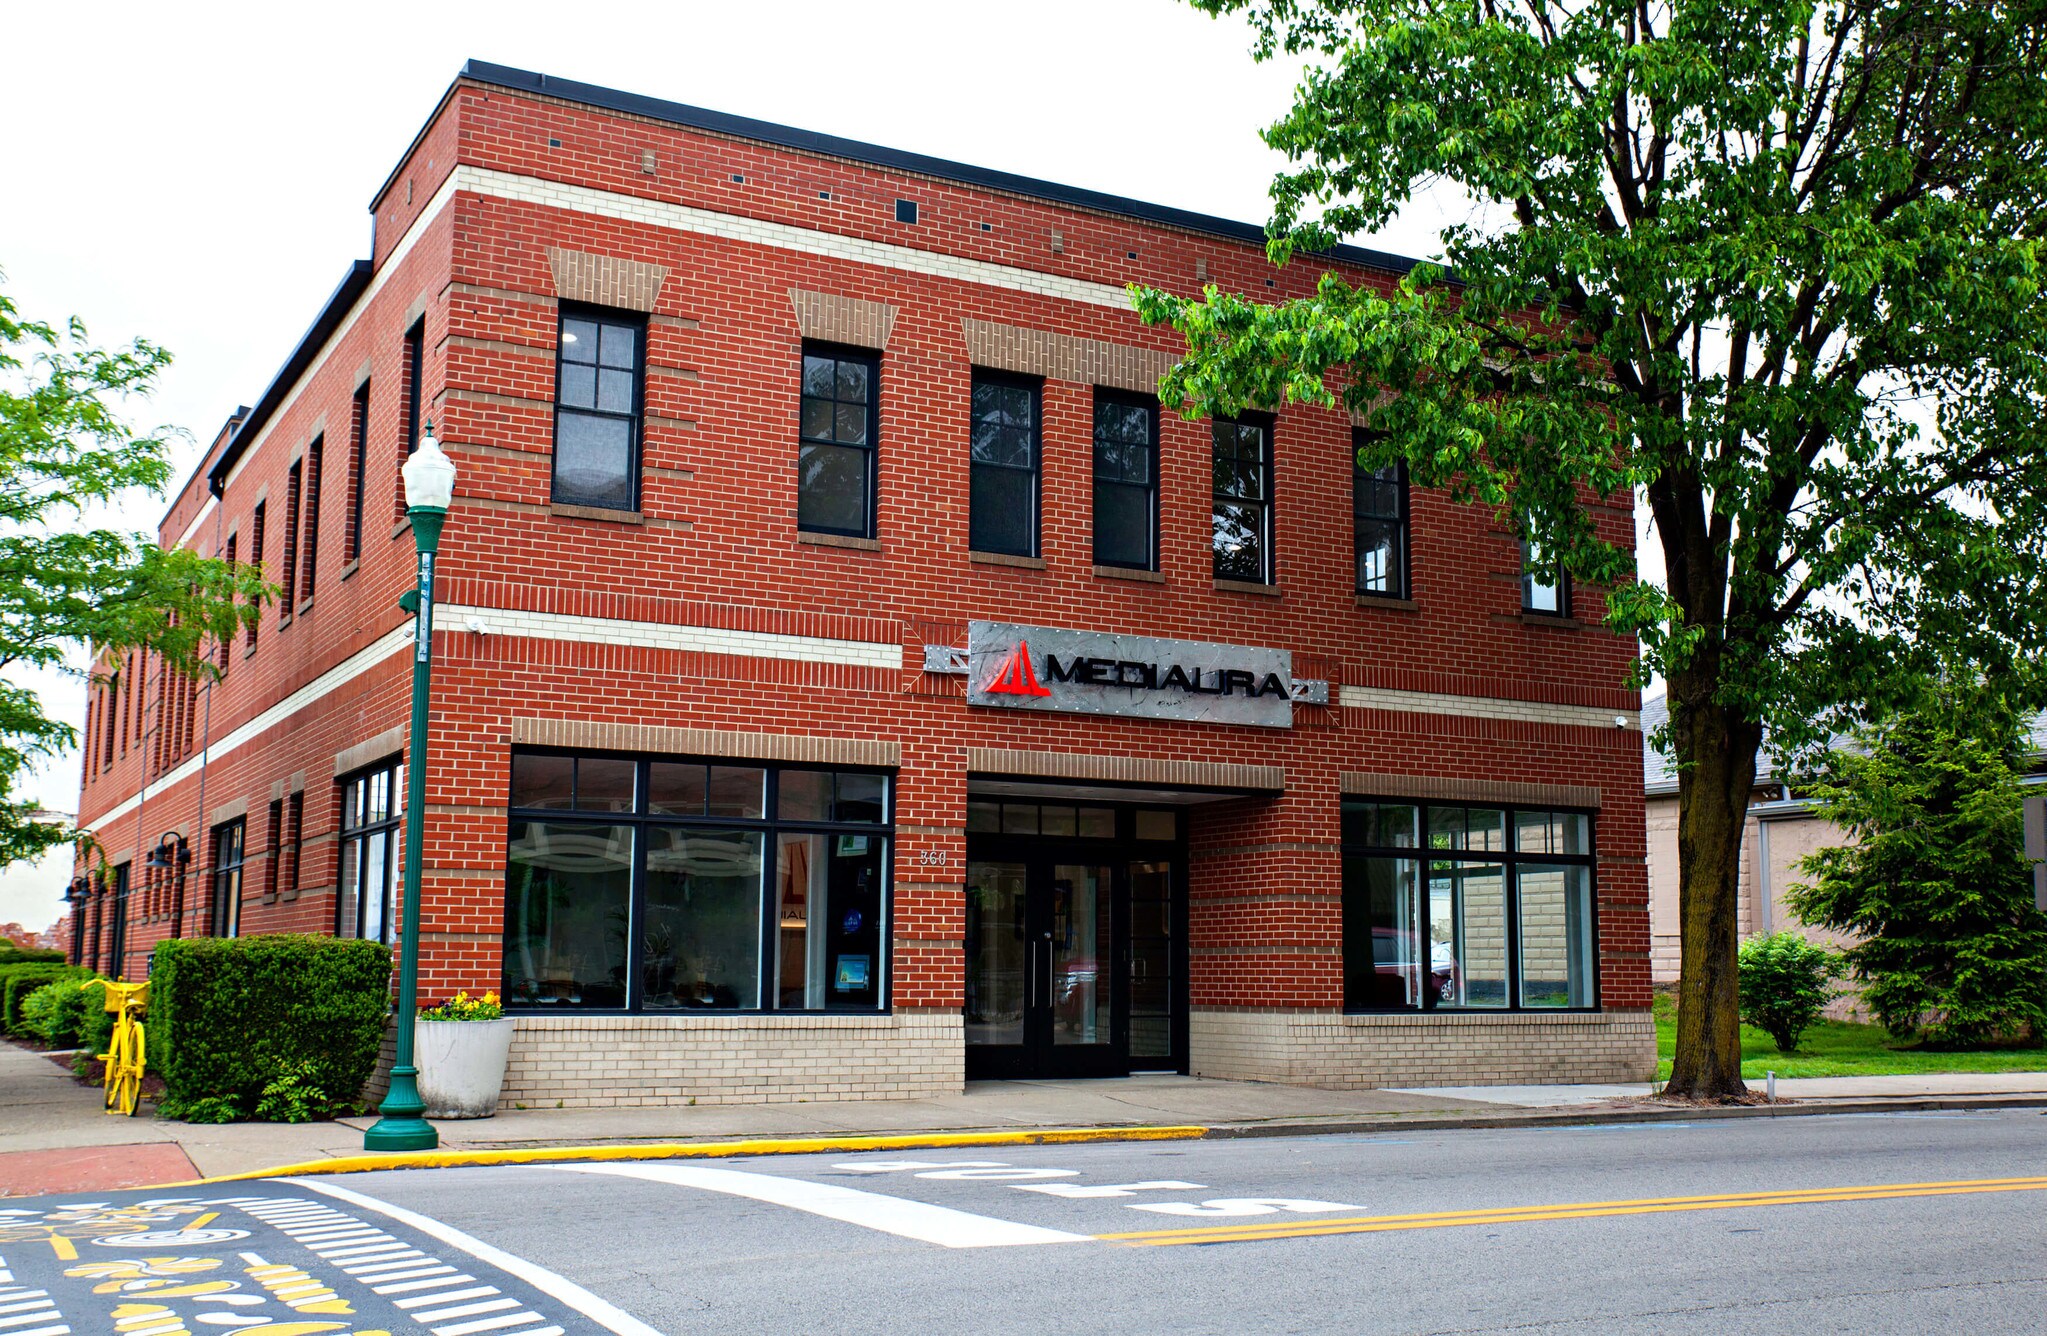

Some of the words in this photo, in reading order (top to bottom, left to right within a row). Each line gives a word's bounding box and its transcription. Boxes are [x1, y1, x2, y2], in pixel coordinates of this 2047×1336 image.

[1047, 654, 1291, 700] MEDIAURA
[920, 850, 947, 866] 360
[831, 1161, 1368, 1216] STOP
